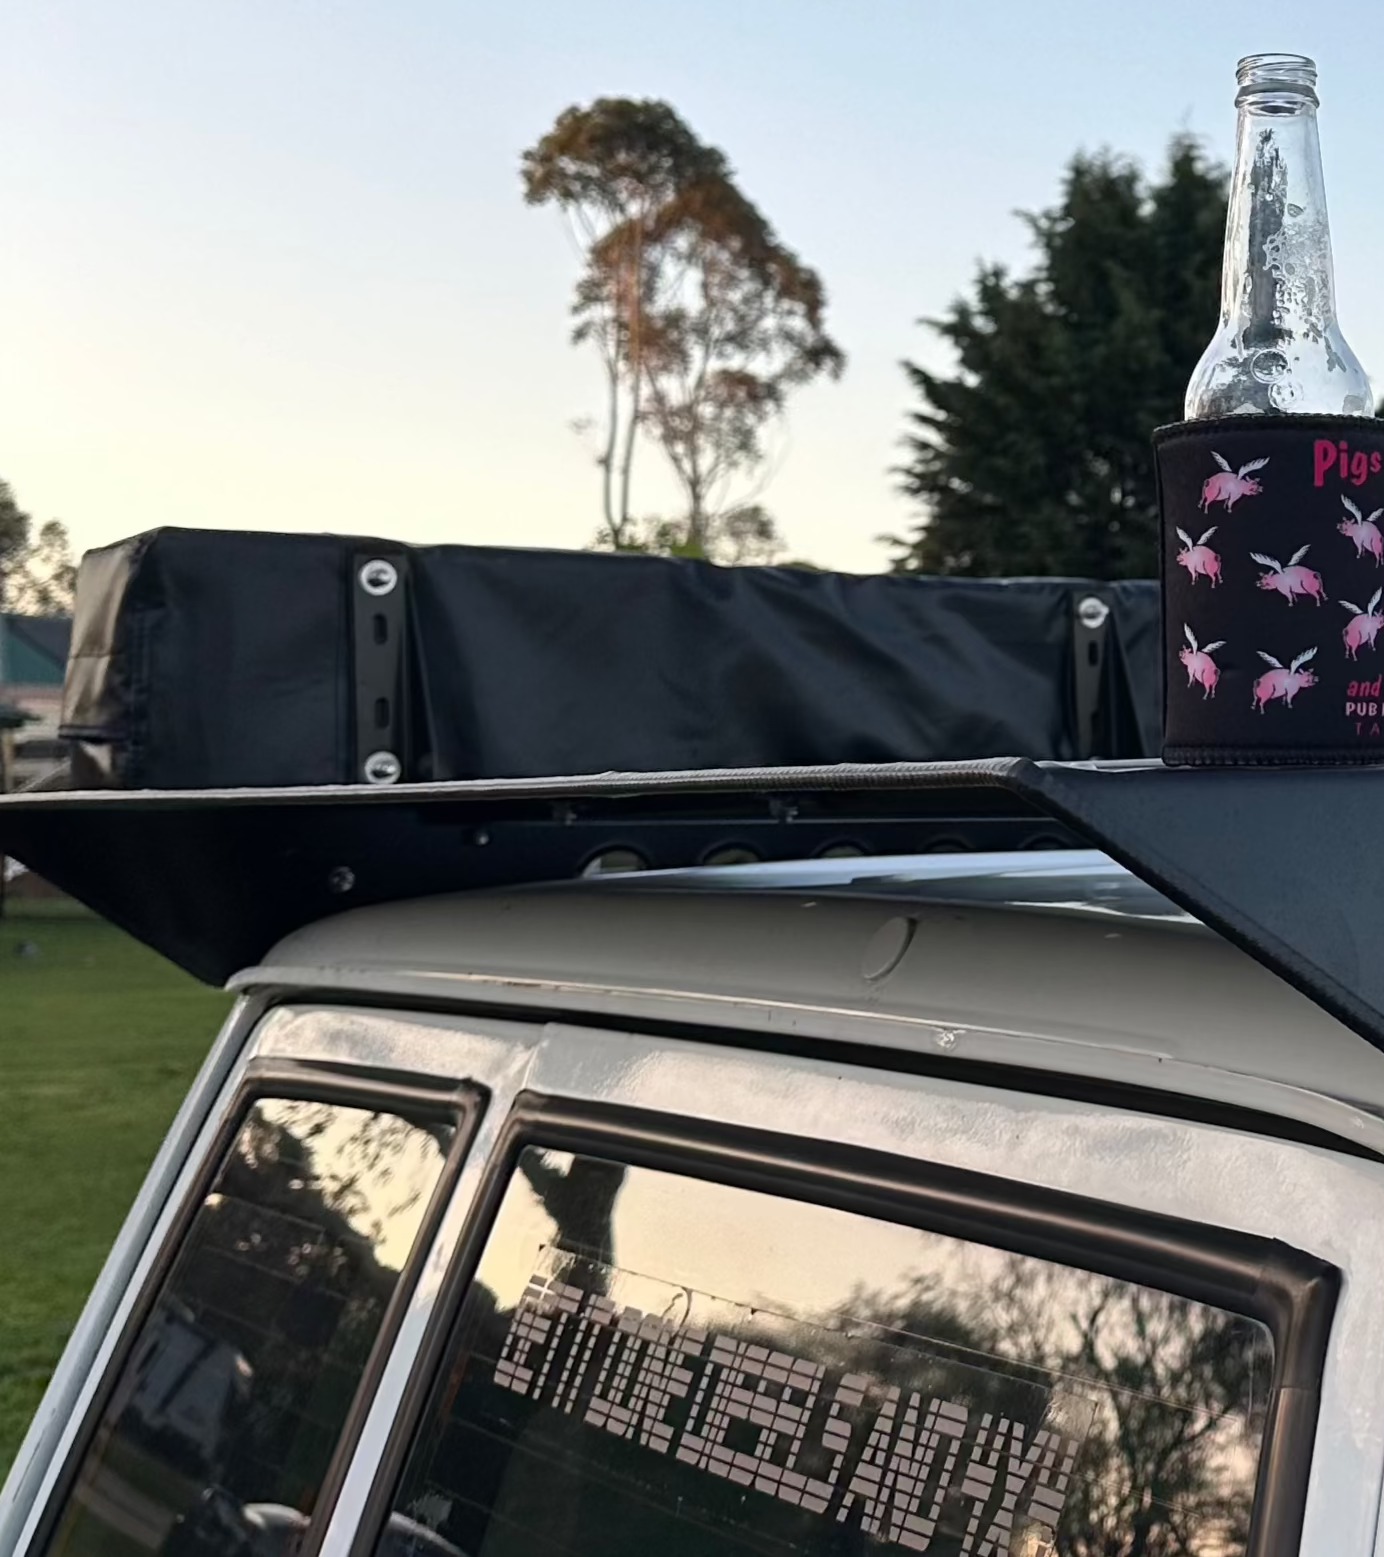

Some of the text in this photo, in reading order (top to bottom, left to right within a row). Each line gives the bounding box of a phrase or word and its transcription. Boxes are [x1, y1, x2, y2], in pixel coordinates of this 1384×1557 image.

[1314, 439, 1382, 486] Pigs
[1347, 673, 1383, 697] and
[1345, 701, 1378, 717] PUB
[493, 1274, 1080, 1557] GET IT DONE DIESELS AND 4X4
